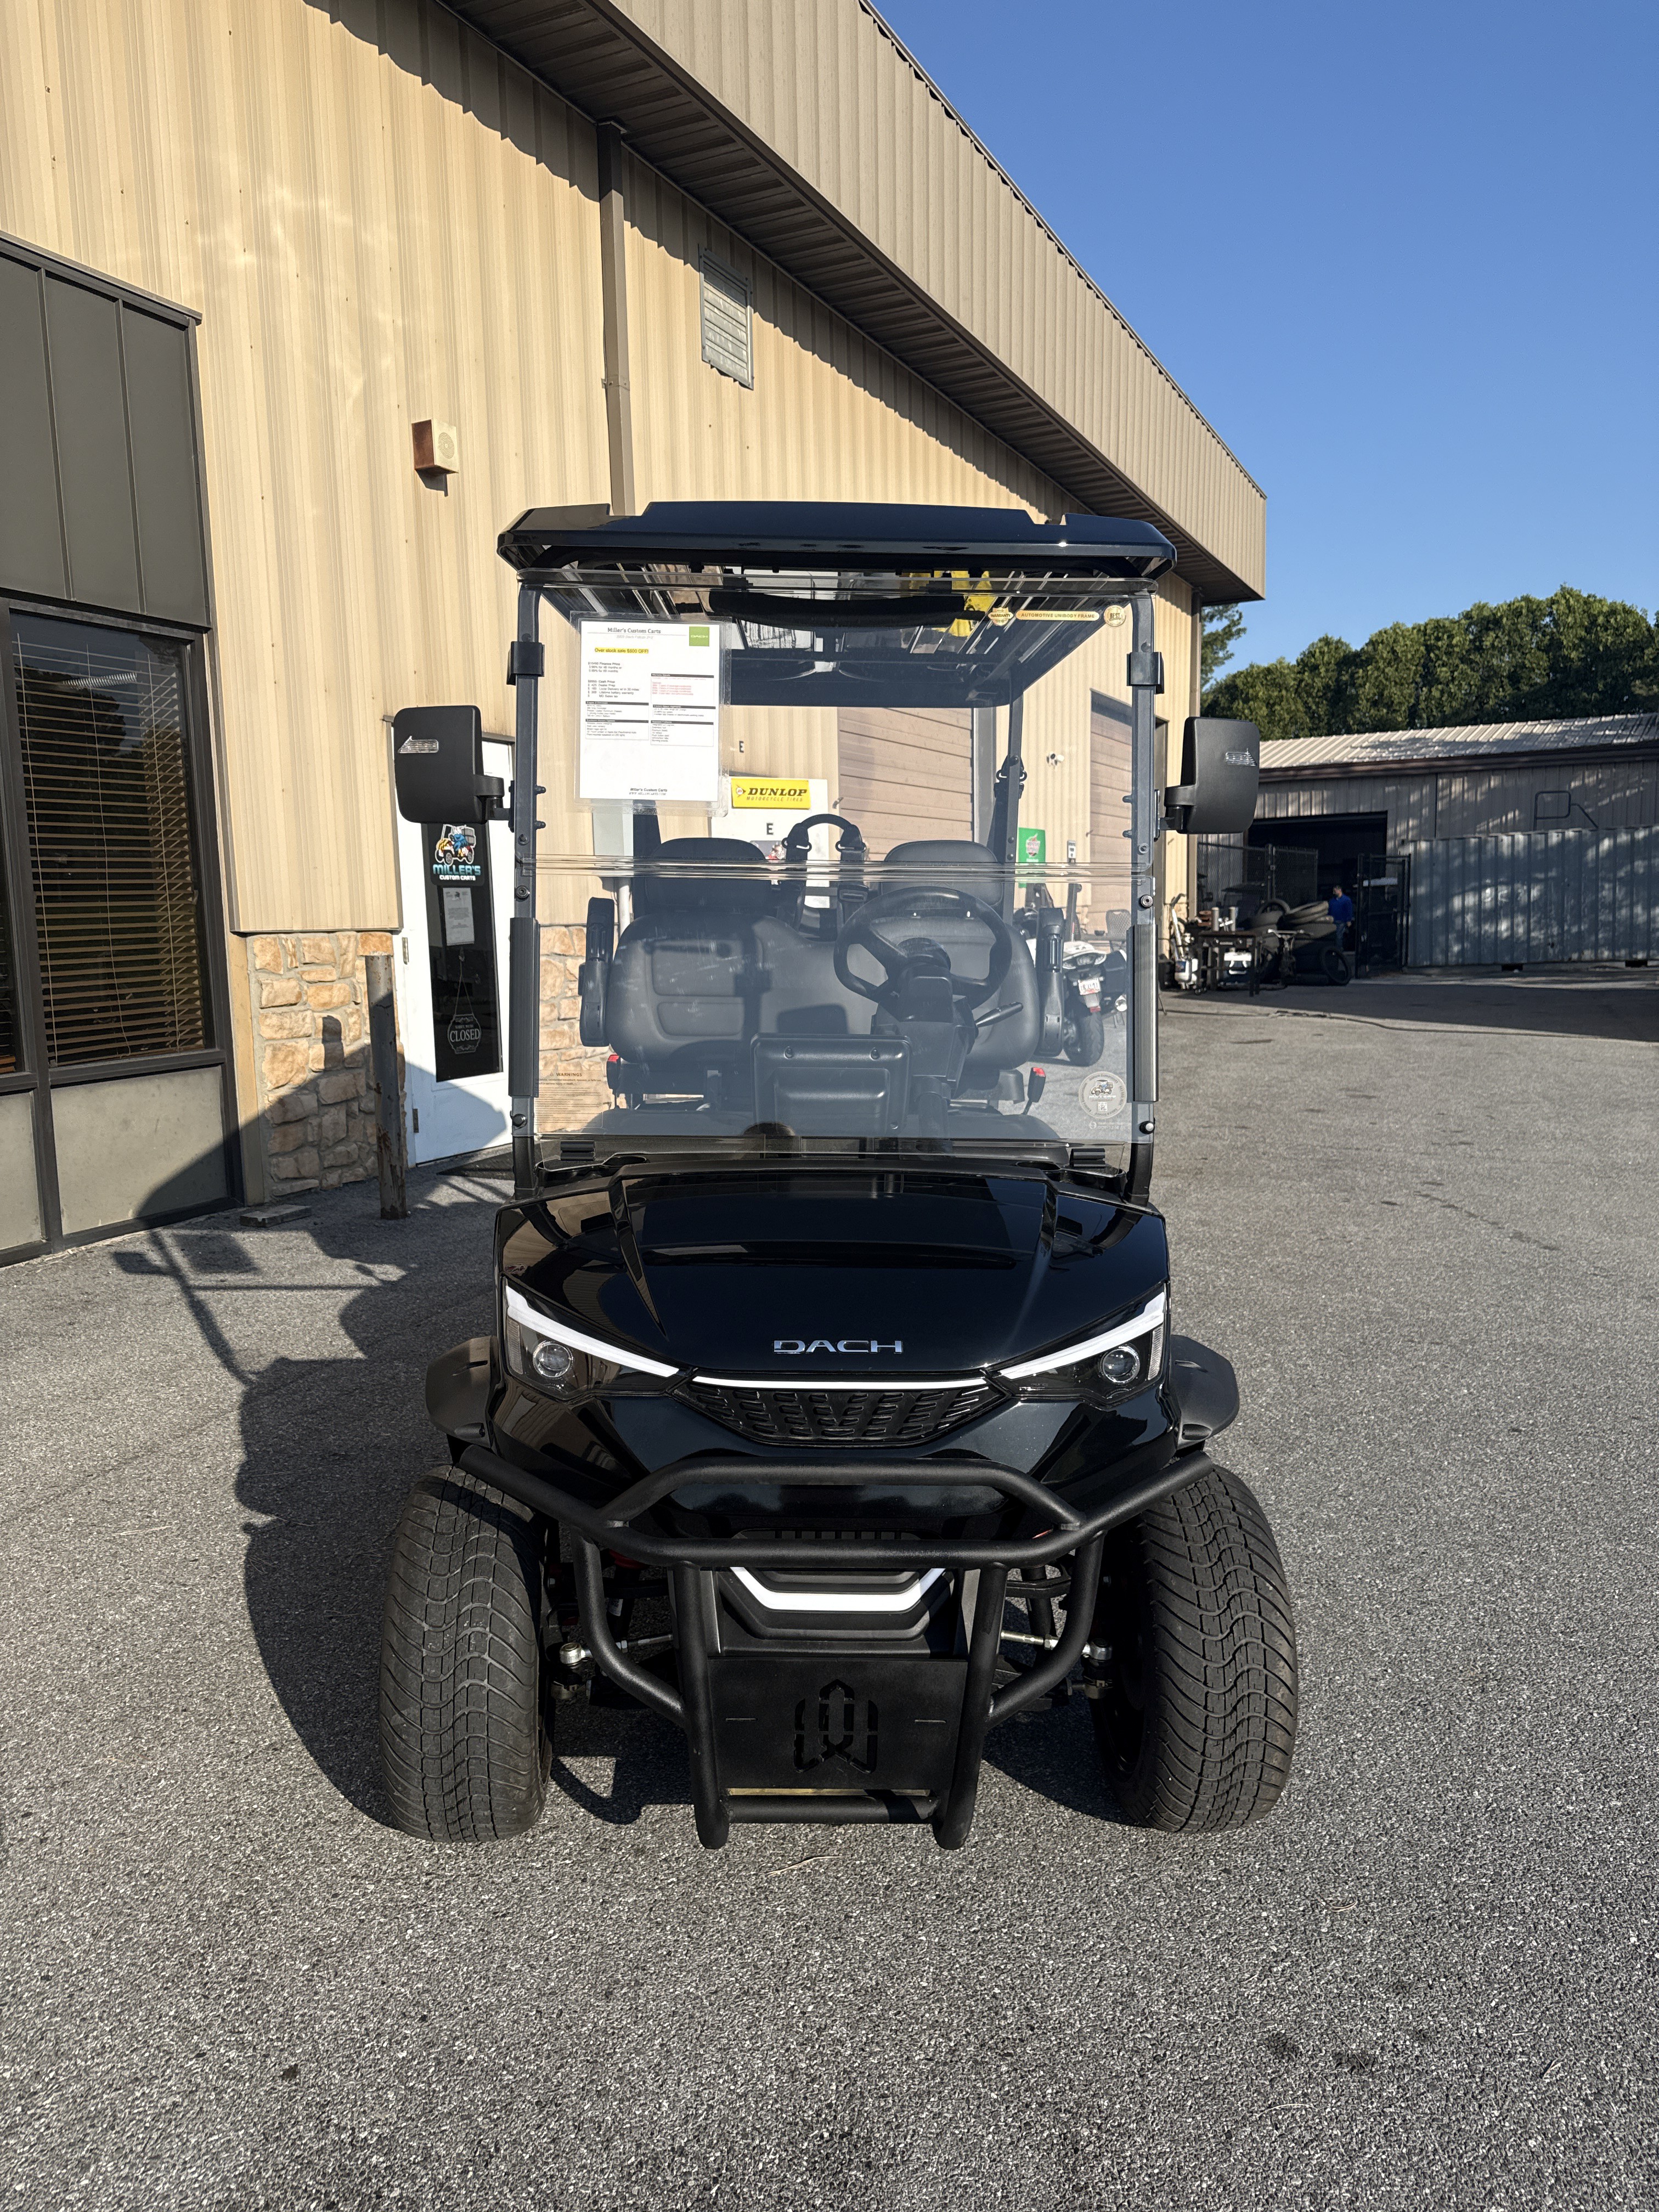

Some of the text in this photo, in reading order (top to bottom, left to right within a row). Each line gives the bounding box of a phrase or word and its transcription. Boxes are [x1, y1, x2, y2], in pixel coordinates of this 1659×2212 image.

[748, 787, 807, 797] DUNLOP
[766, 823, 774, 835] E
[432, 864, 482, 876] MILLER'S
[449, 1028, 480, 1042] CLOSED
[774, 1340, 902, 1353] DACH
